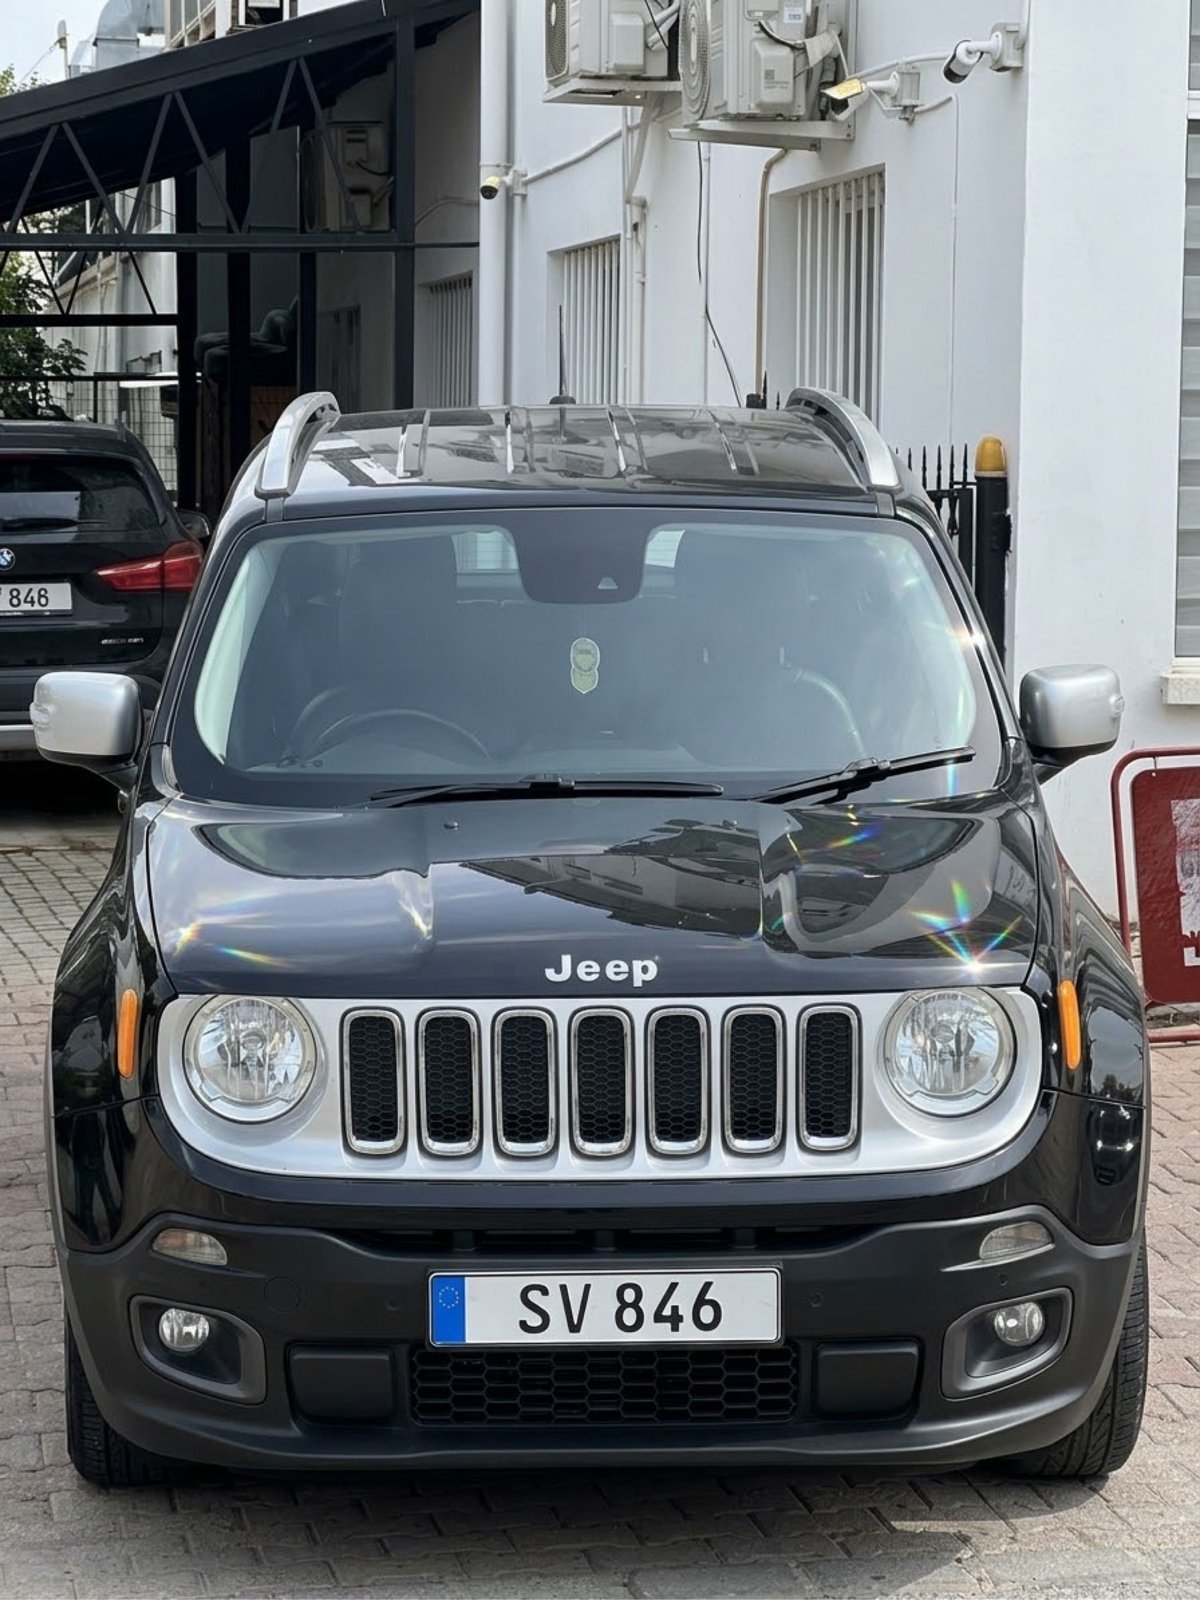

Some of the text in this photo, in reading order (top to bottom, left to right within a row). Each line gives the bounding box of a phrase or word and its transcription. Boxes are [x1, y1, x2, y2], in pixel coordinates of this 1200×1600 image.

[9, 587, 49, 608] 846
[544, 953, 659, 988] Jeep
[518, 1280, 723, 1335] SV 846
